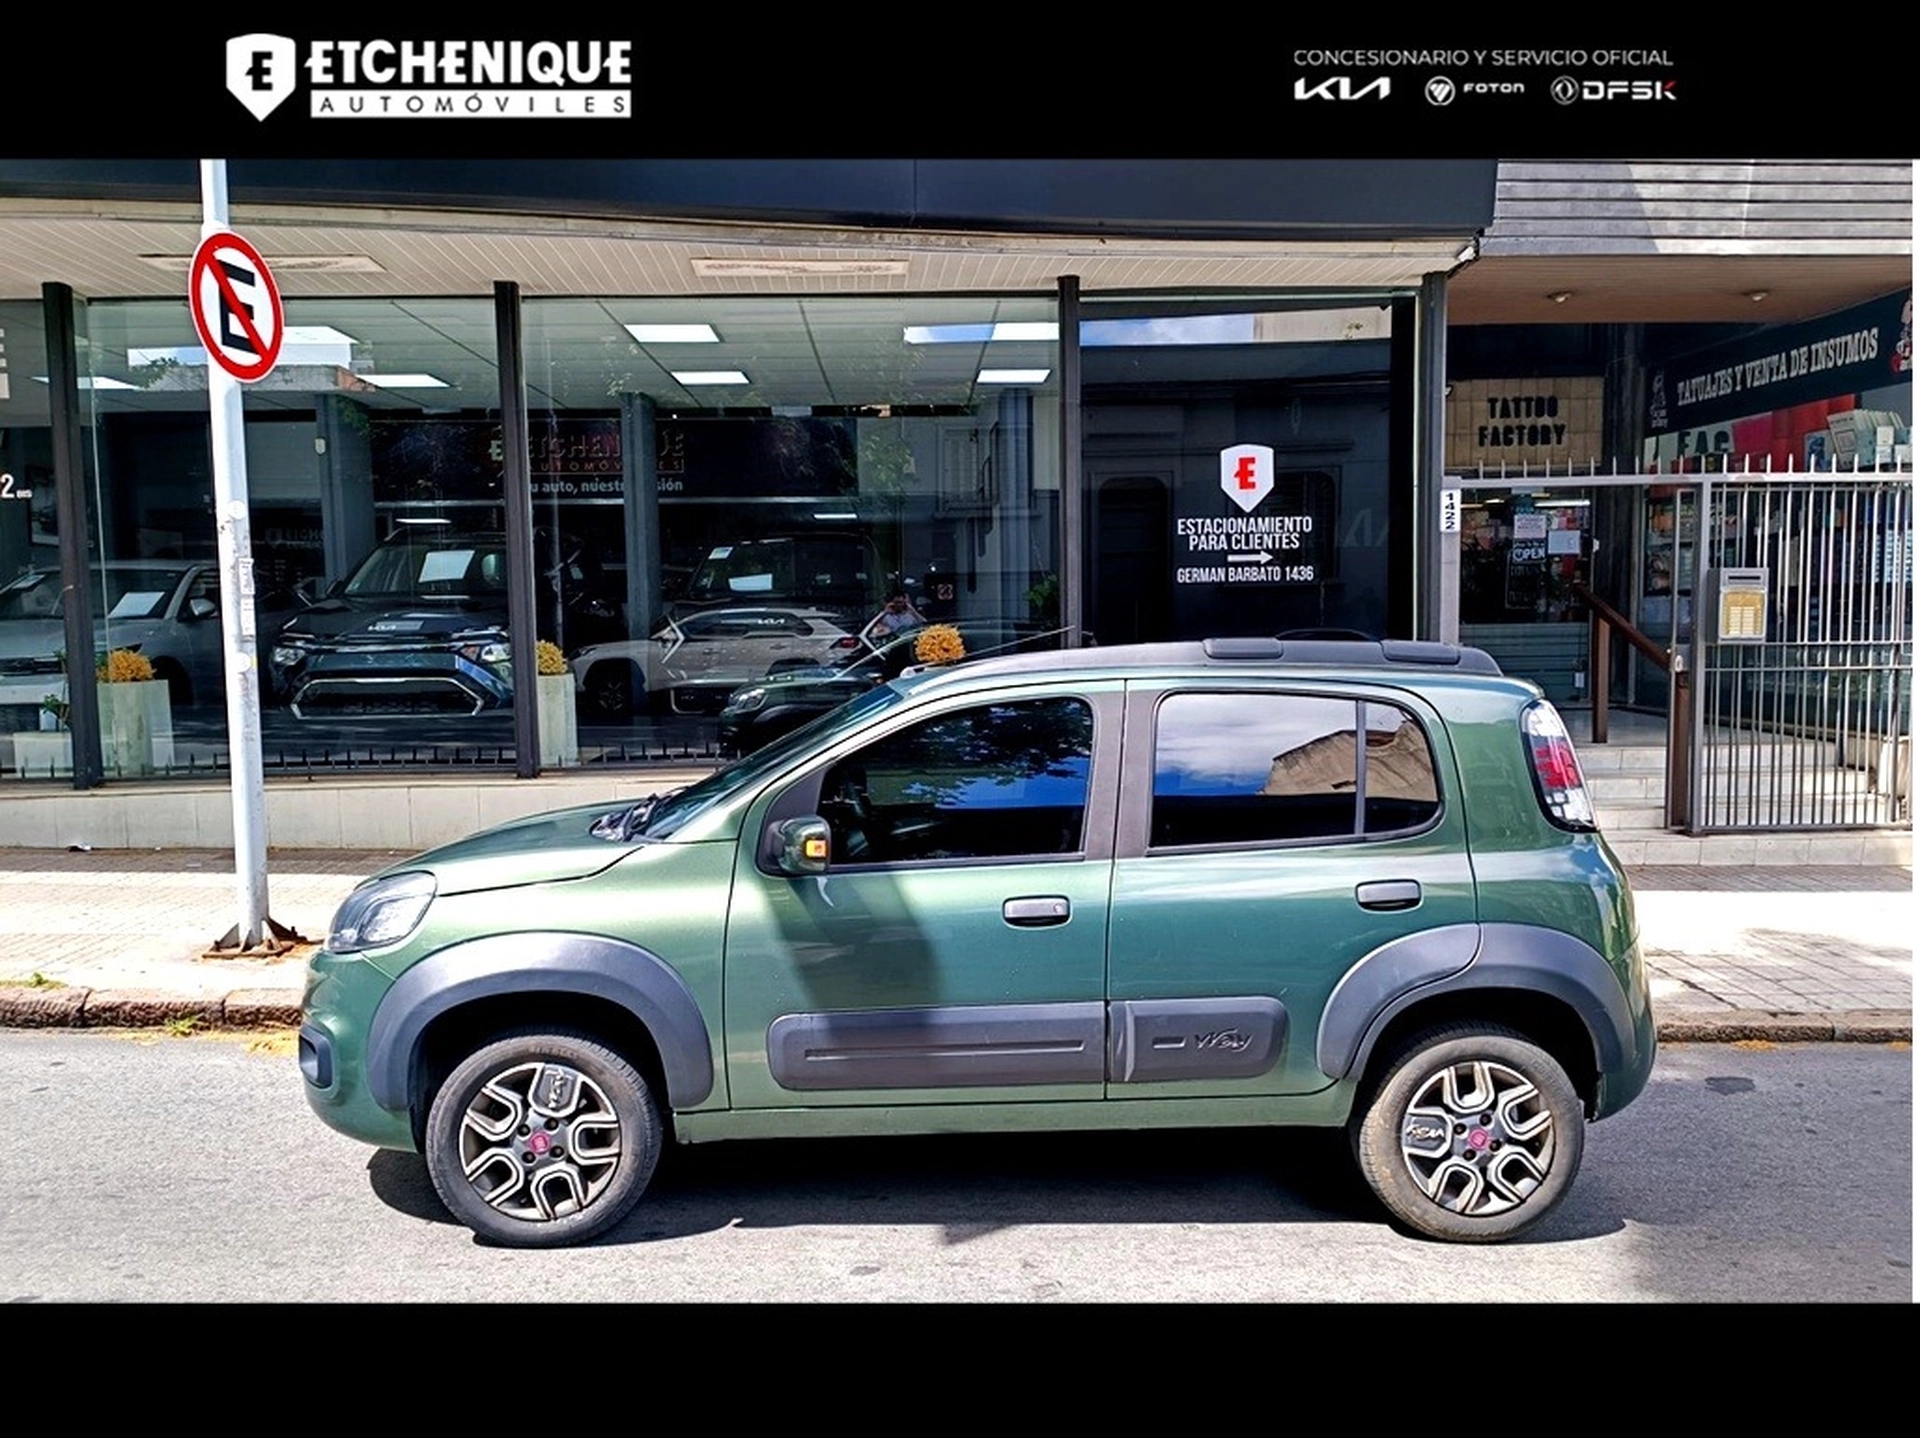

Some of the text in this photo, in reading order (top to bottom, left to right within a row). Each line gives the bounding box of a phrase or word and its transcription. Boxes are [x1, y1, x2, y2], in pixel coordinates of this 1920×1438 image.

[217, 259, 260, 355] E
[1677, 327, 1878, 406] TATUAJES Y VENTA DE INSUMOS
[1487, 396, 1559, 419] TATTOO
[1478, 424, 1566, 447] FACTORY
[1234, 457, 1256, 489] E
[1445, 492, 1456, 530] 1422
[1177, 516, 1312, 535] ESTACIONAMIENTO
[1189, 533, 1300, 551] PARA CLIENTES
[1177, 566, 1314, 583] GERMAN BARBATO 1436
